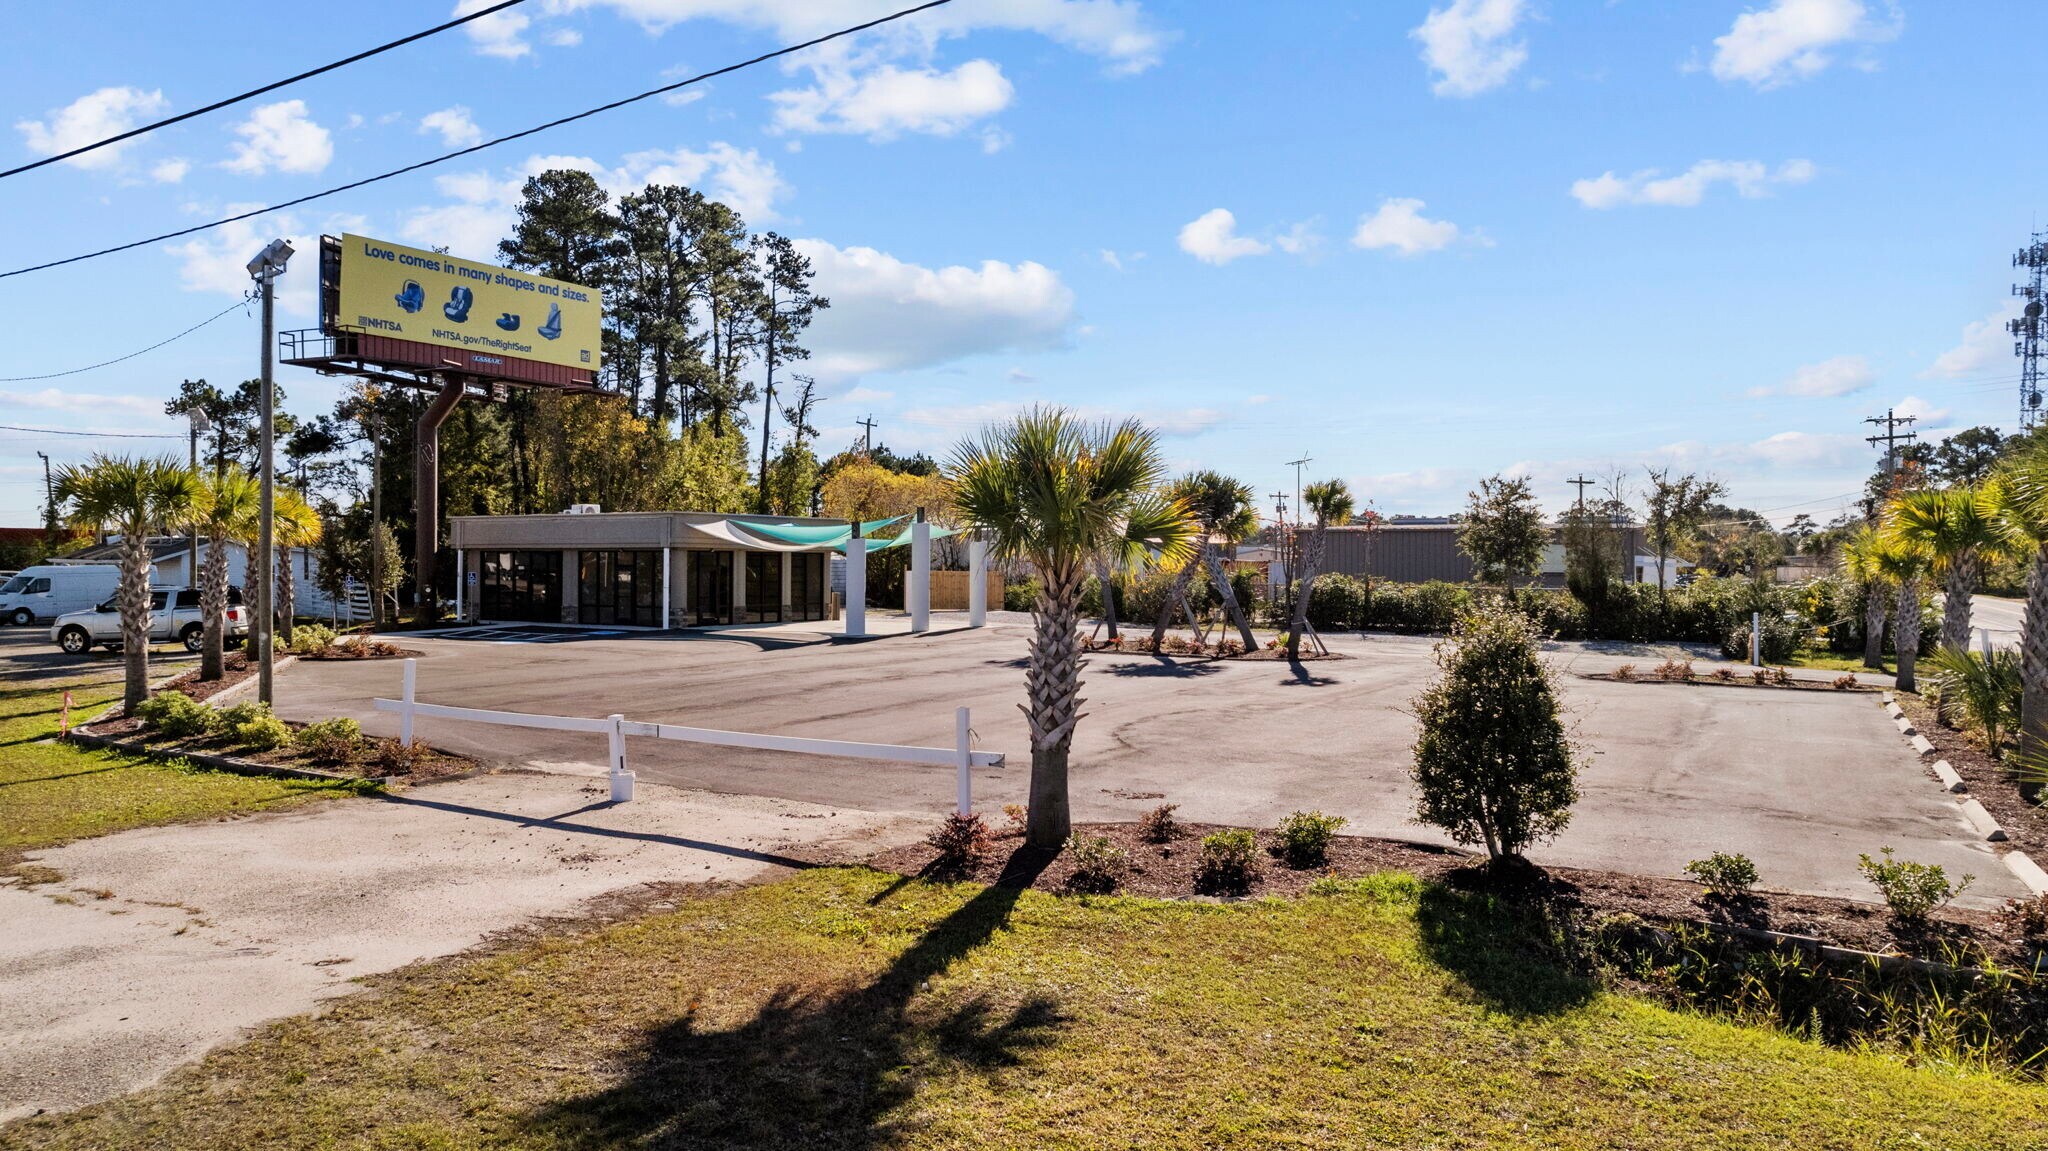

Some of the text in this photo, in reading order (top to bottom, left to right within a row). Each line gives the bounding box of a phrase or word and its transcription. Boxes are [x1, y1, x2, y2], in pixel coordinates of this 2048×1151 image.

[365, 243, 590, 303] Love comes in many shapes and sizes.
[367, 317, 403, 332] NHTSA
[432, 329, 532, 353] NHTSA.gov/TheRightSeat
